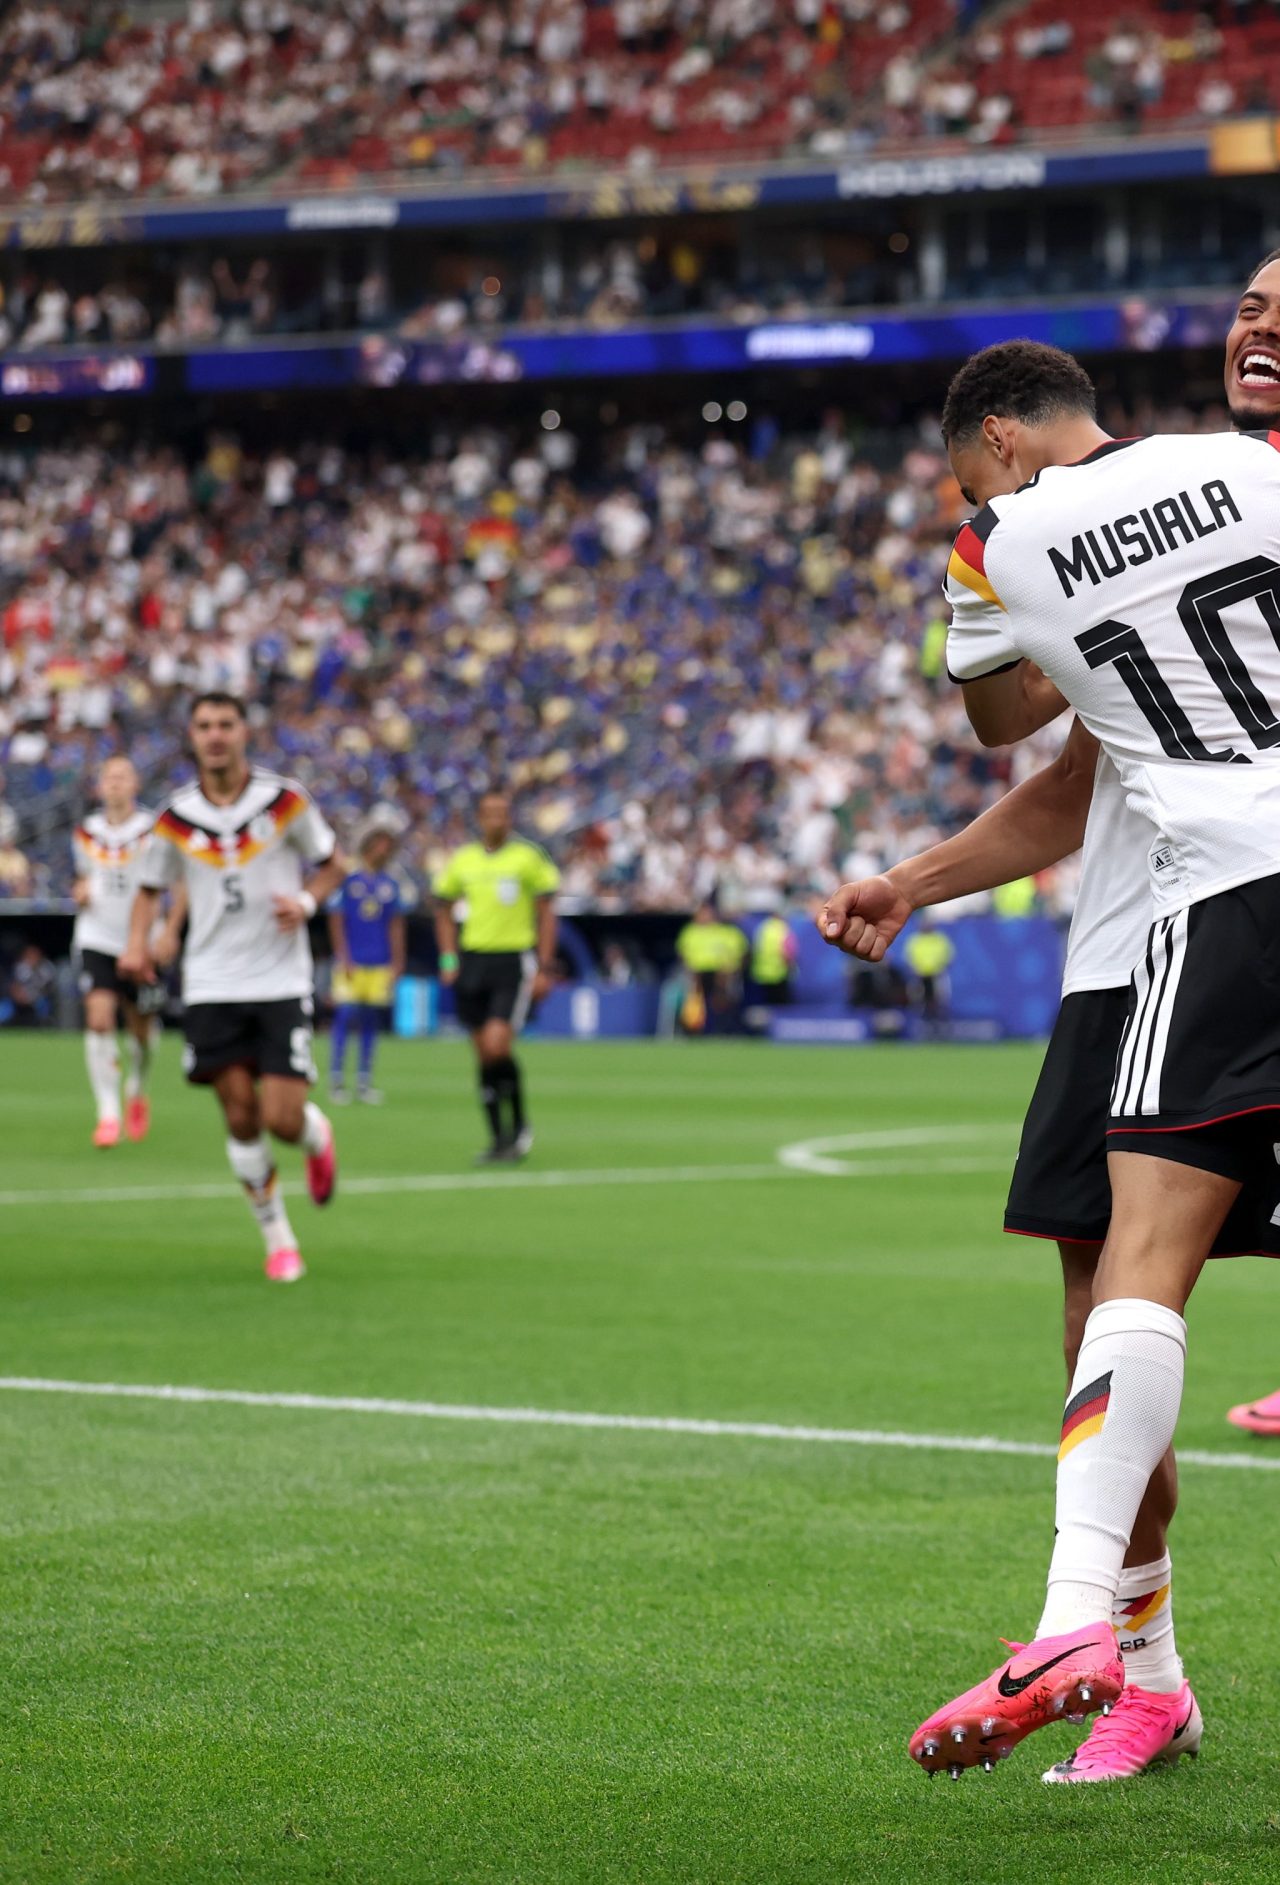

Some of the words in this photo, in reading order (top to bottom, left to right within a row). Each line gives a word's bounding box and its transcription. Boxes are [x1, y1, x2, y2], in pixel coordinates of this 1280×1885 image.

[837, 154, 1046, 199] HOUSTON
[1047, 479, 1242, 599] MUSIALA
[223, 875, 245, 913] 5
